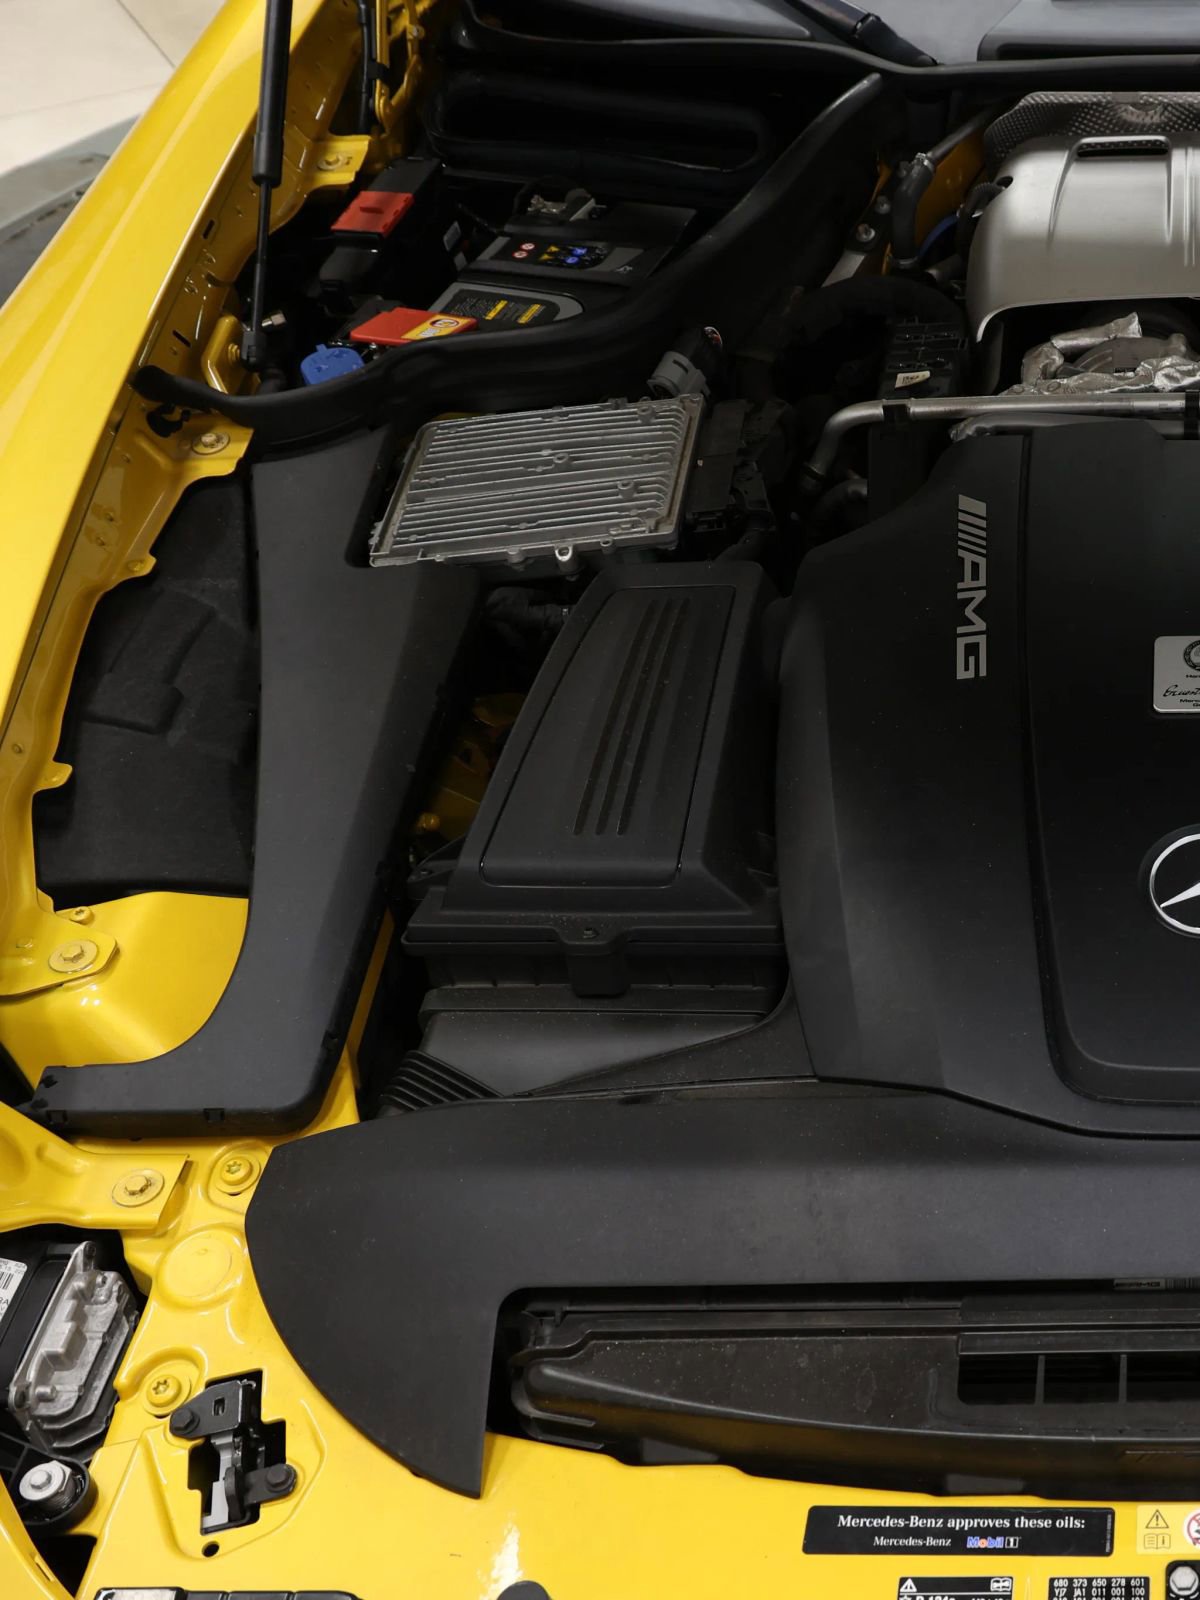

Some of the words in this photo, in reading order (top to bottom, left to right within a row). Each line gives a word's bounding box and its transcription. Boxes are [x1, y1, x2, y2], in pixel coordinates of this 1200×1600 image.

[957, 549, 987, 680] AMG
[837, 1514, 944, 1528] Mercedes-Benz
[947, 1516, 1011, 1531] approves
[1014, 1516, 1052, 1528] these
[1055, 1516, 1086, 1528] oils:
[873, 1536, 952, 1547] Mercedes-Benz
[966, 1536, 1005, 1549] Mobil
